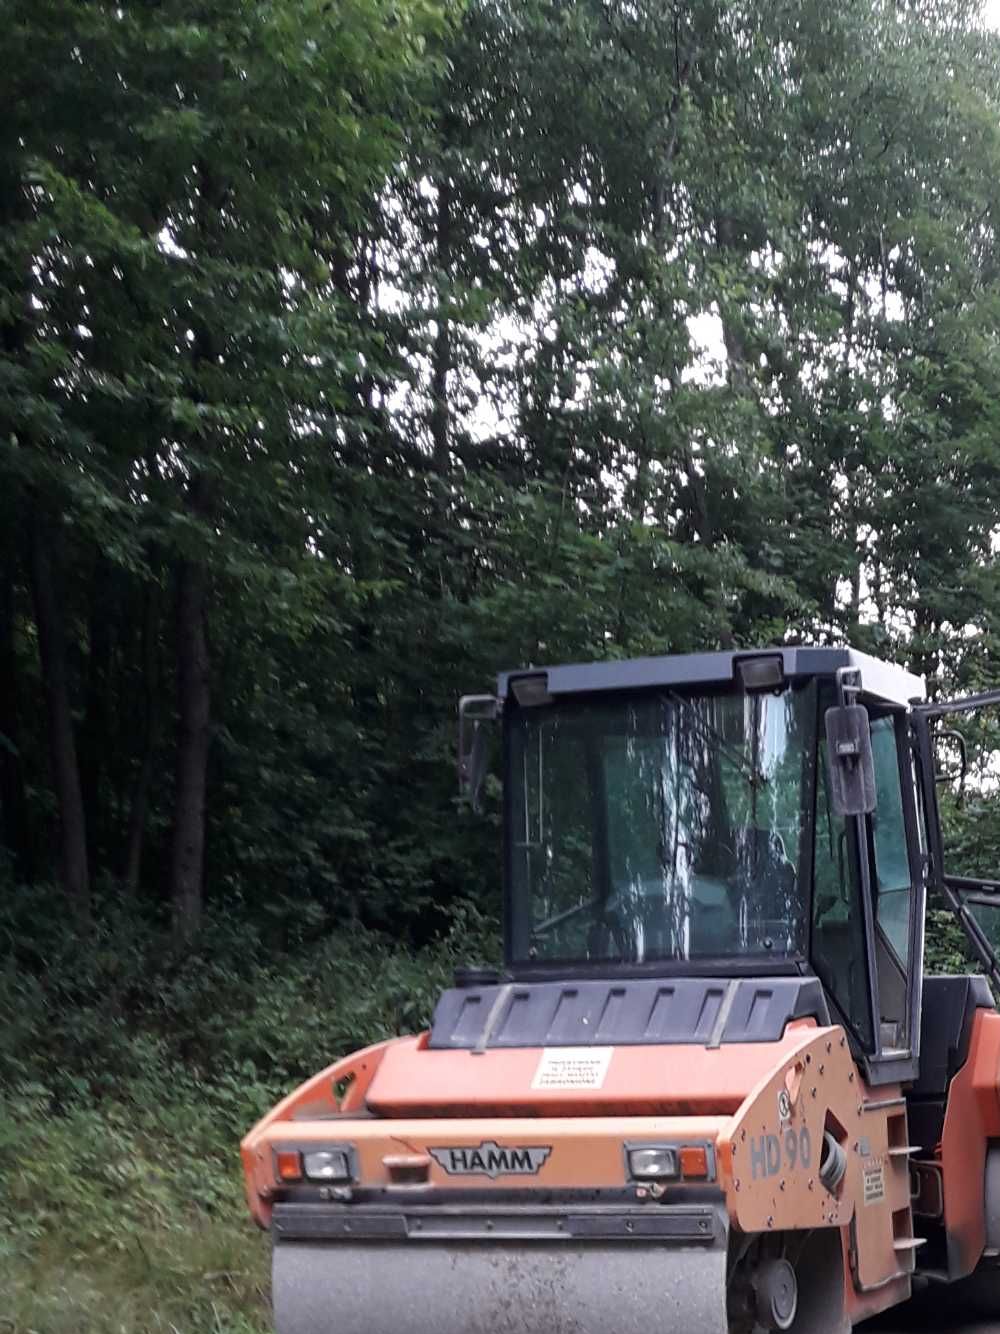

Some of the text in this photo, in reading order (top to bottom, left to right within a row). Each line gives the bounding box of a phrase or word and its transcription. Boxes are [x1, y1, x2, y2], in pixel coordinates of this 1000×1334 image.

[450, 1150, 533, 1170] HAMM
[752, 1127, 810, 1179] HD 90
